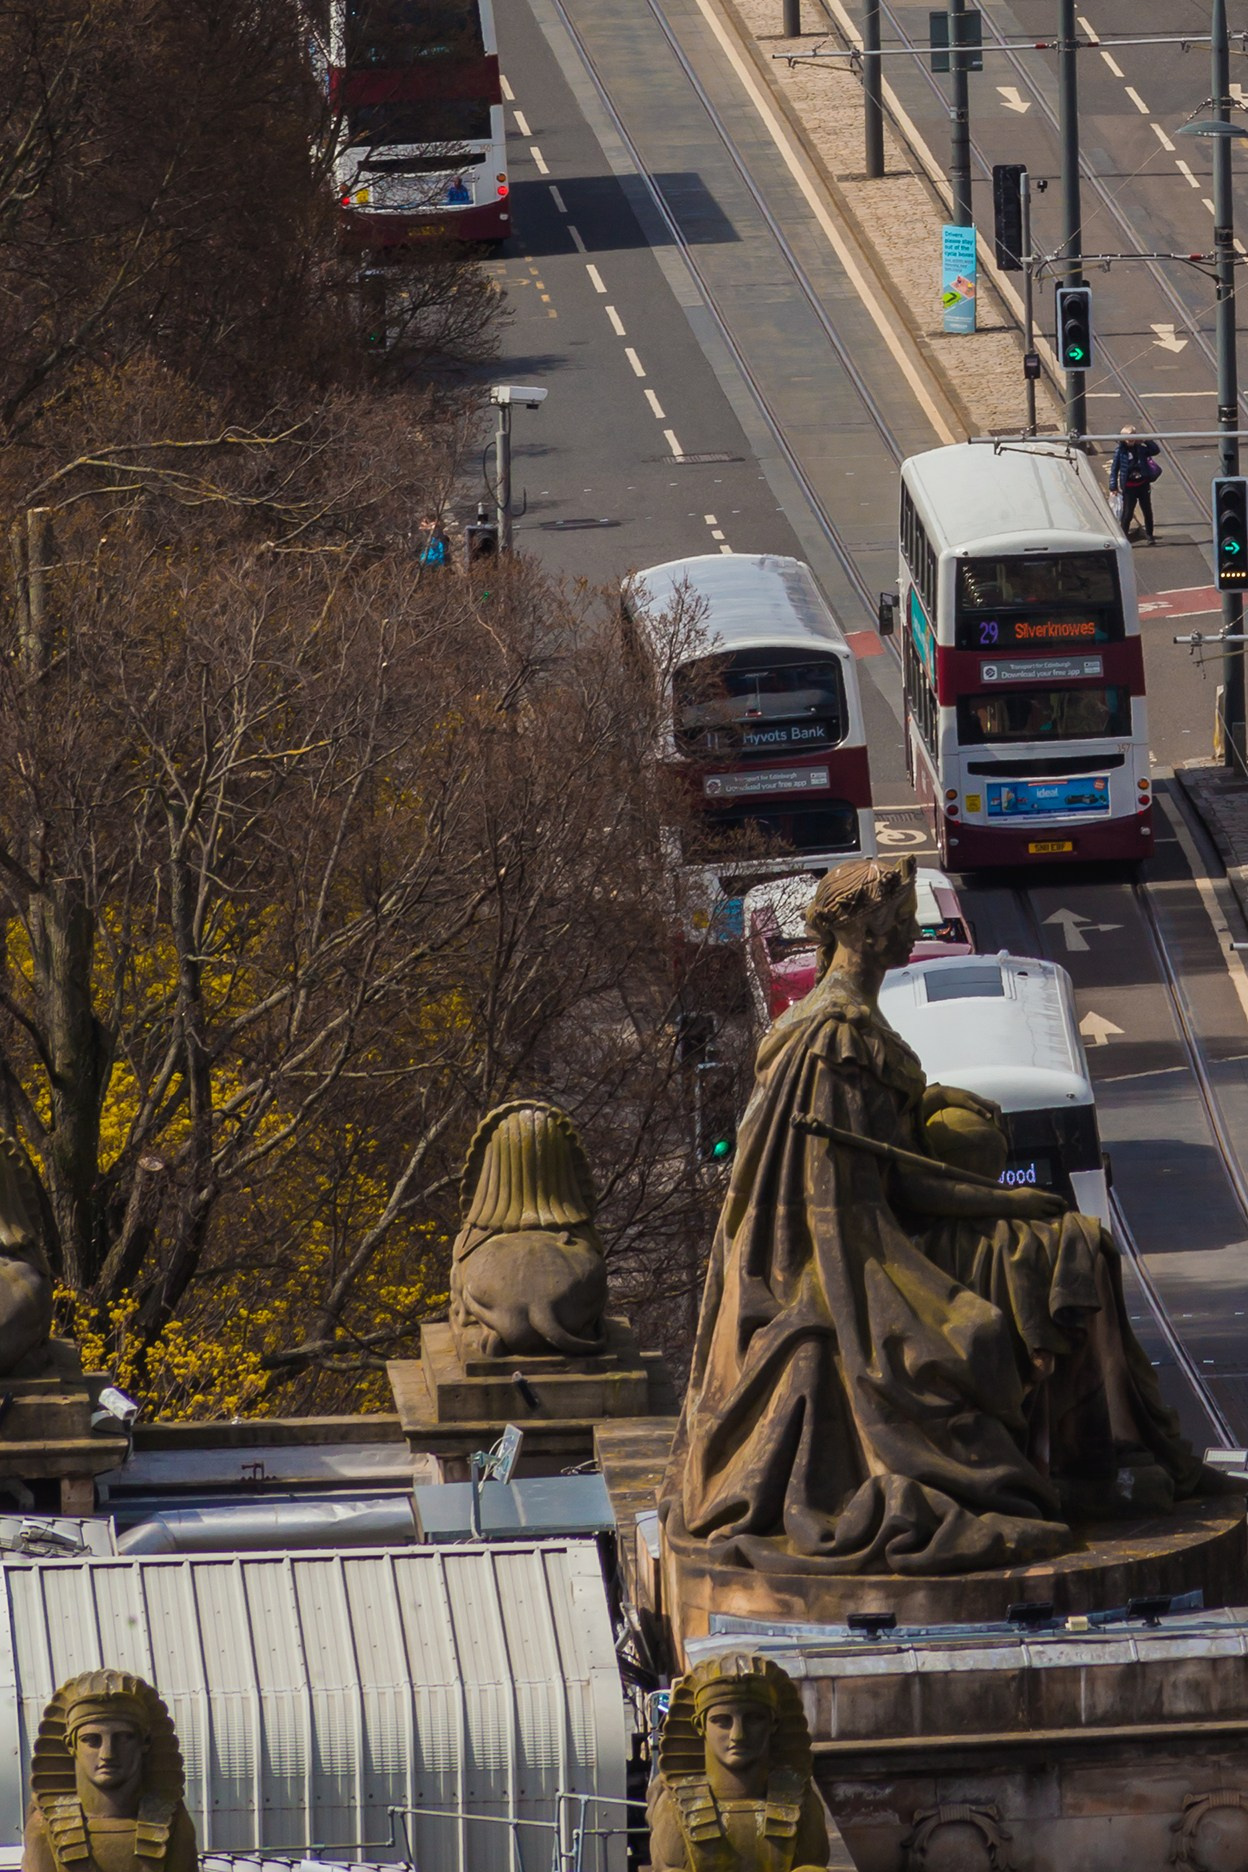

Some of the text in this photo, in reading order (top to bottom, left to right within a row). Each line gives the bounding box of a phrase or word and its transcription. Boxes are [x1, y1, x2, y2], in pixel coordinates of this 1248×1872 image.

[979, 621, 1096, 645] 29 Silverknowes
[1001, 668, 1081, 679] Download your free app
[743, 730, 788, 745] Hyvots
[791, 726, 825, 741] Bank
[761, 782, 777, 791] your
[779, 779, 793, 788] free
[793, 779, 807, 789] app
[1036, 787, 1059, 798] ideal
